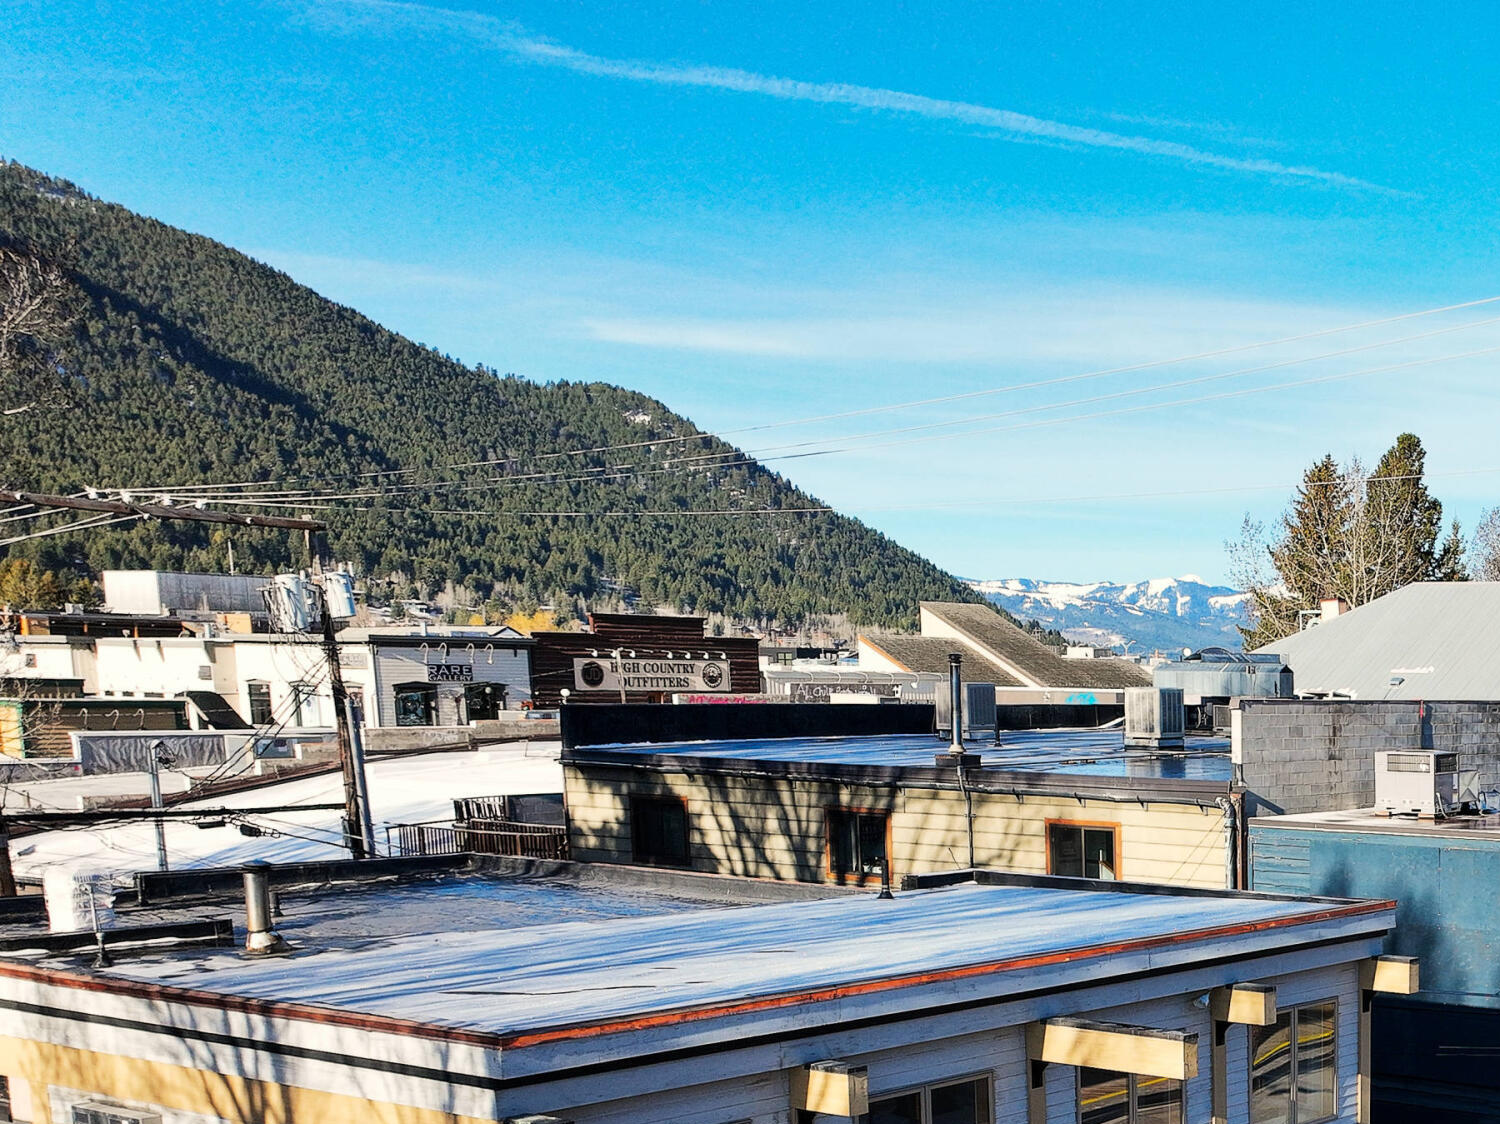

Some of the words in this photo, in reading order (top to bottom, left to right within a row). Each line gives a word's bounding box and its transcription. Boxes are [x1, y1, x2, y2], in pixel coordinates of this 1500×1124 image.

[429, 665, 472, 675] RARE
[610, 662, 640, 674] HGH
[644, 662, 695, 674] COUNTRY
